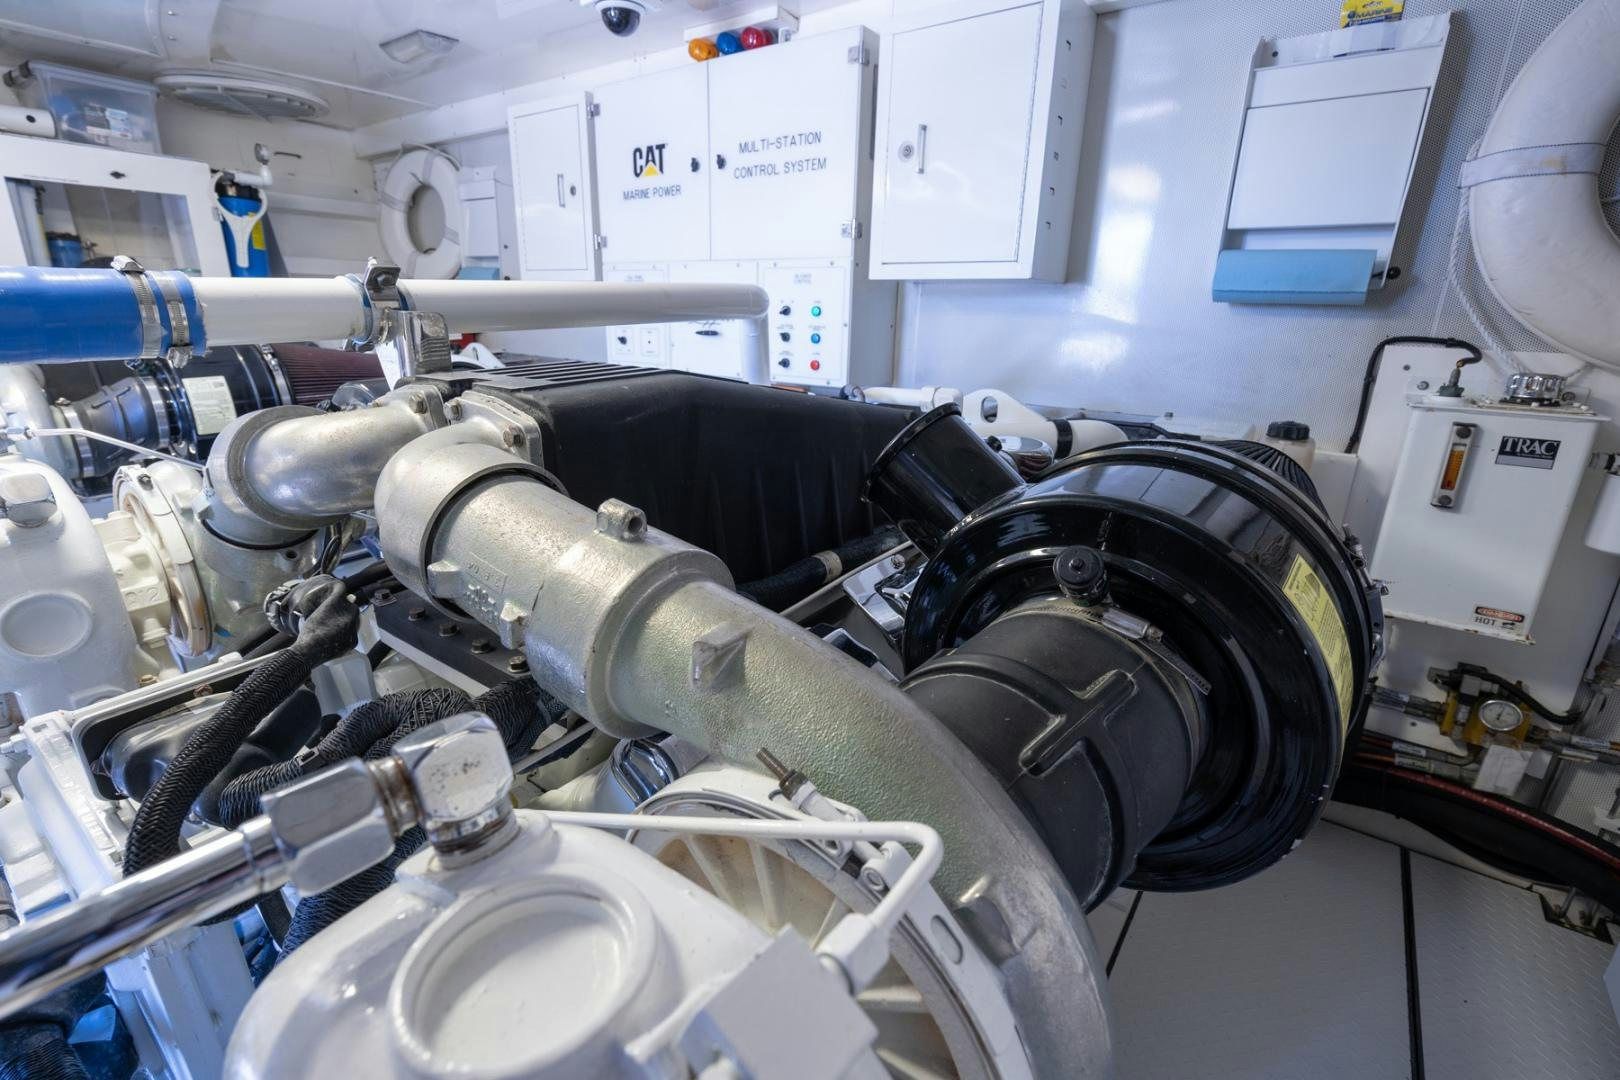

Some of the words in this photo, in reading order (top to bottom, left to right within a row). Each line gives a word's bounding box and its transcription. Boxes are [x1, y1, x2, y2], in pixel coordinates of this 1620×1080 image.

[739, 132, 822, 153] MULTI-STATION
[633, 144, 666, 178] CAT
[734, 164, 779, 179] CONTROL
[784, 158, 827, 174] SYSTEM
[623, 188, 650, 200] MARINE
[653, 185, 682, 197] POWER
[1503, 437, 1557, 455] TRAC
[1475, 616, 1496, 625] HOT
